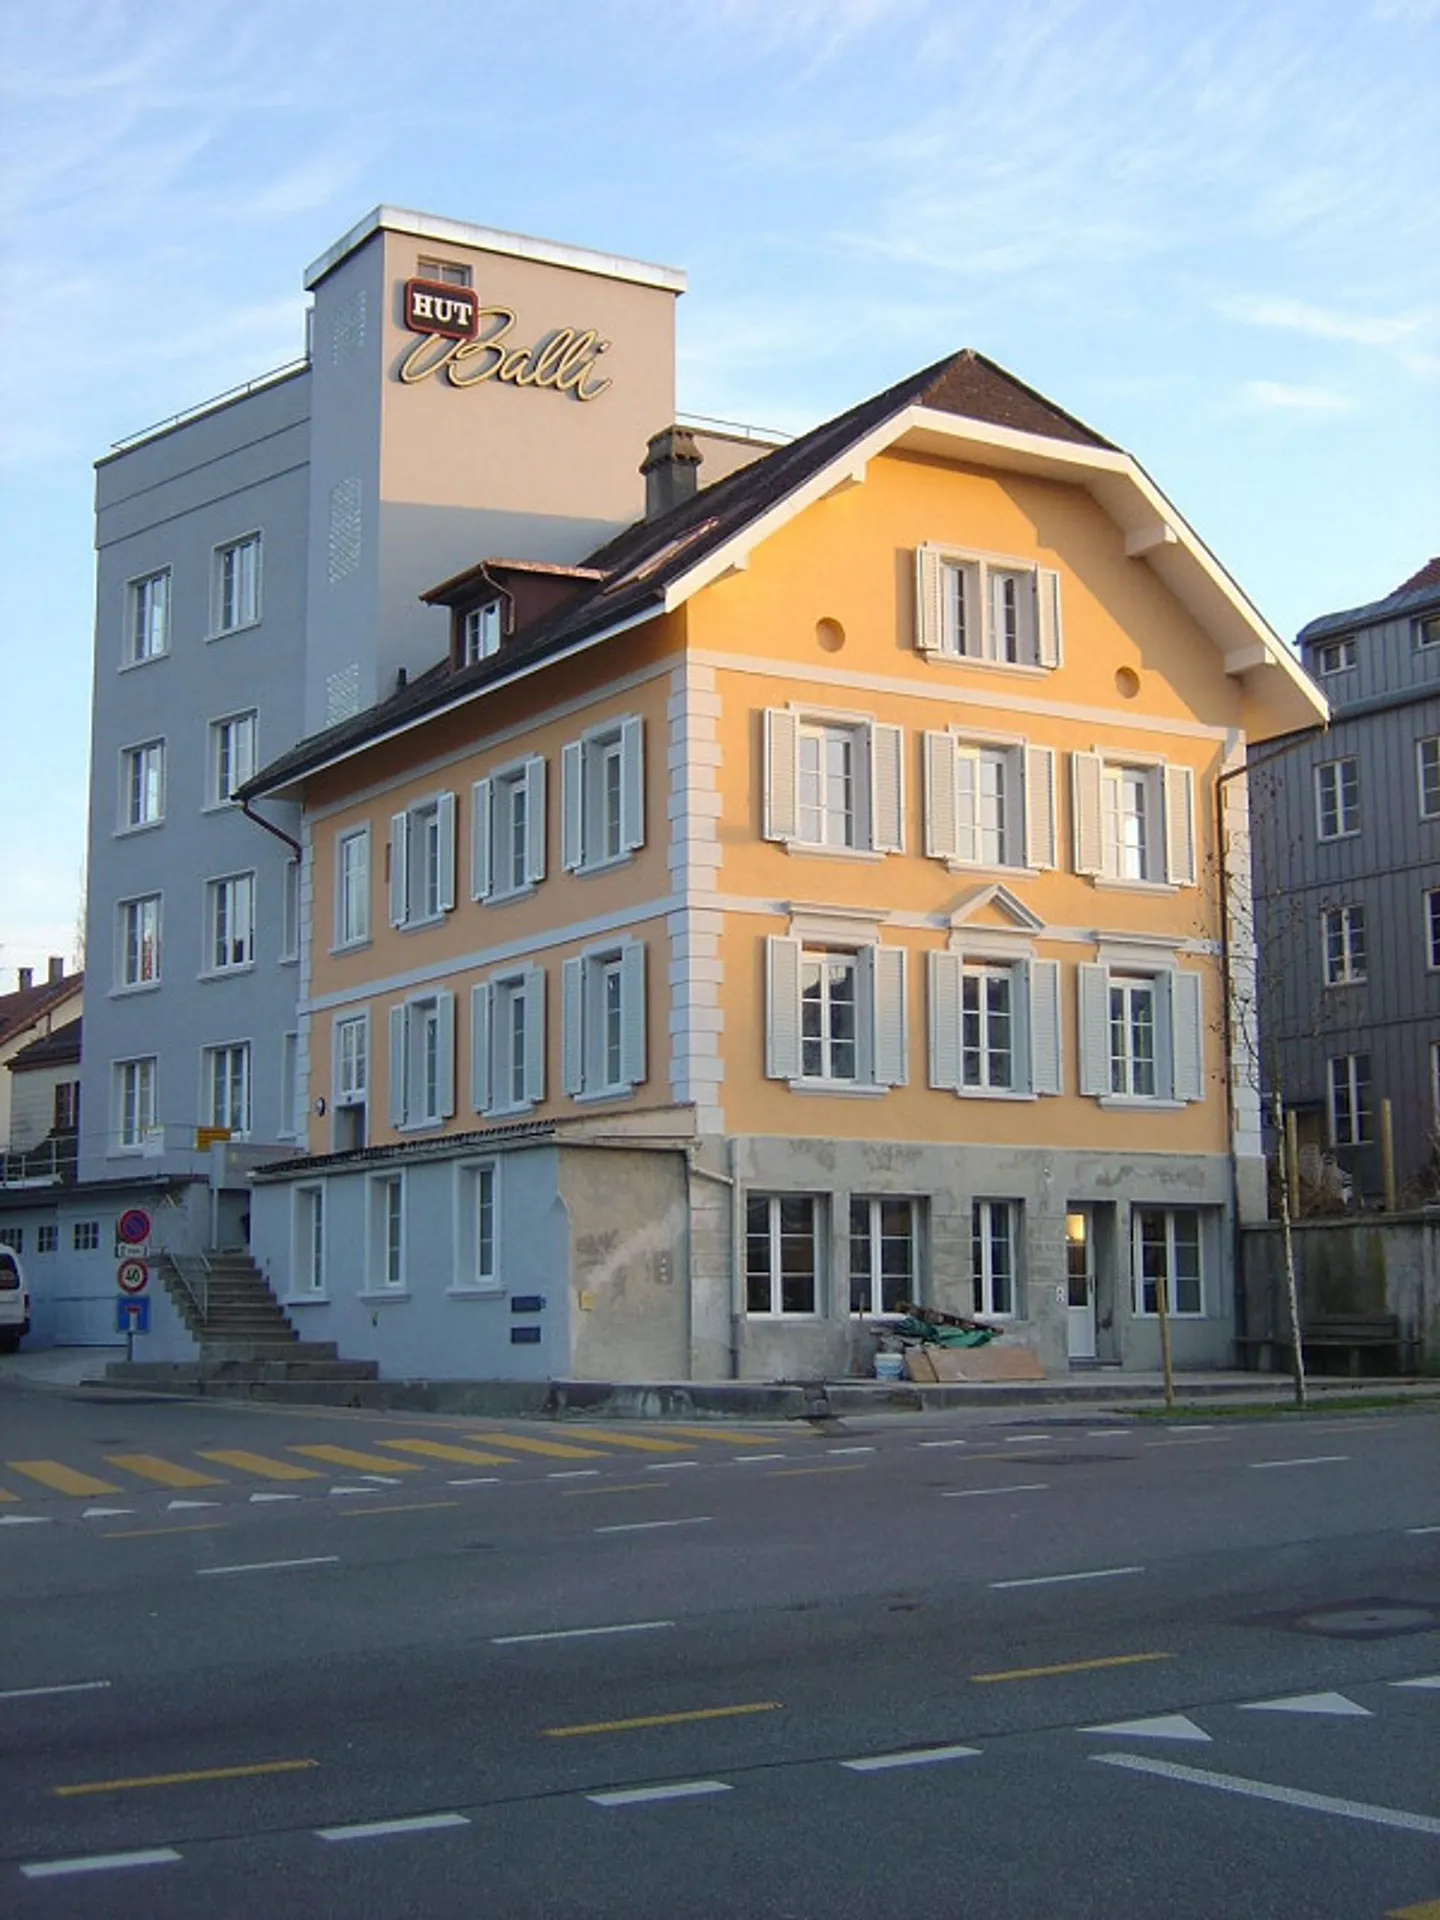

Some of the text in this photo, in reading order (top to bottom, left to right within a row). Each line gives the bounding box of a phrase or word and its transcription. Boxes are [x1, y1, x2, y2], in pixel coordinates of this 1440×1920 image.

[412, 292, 473, 326] HUT
[401, 305, 612, 402] Balli
[125, 1268, 140, 1283] 40
